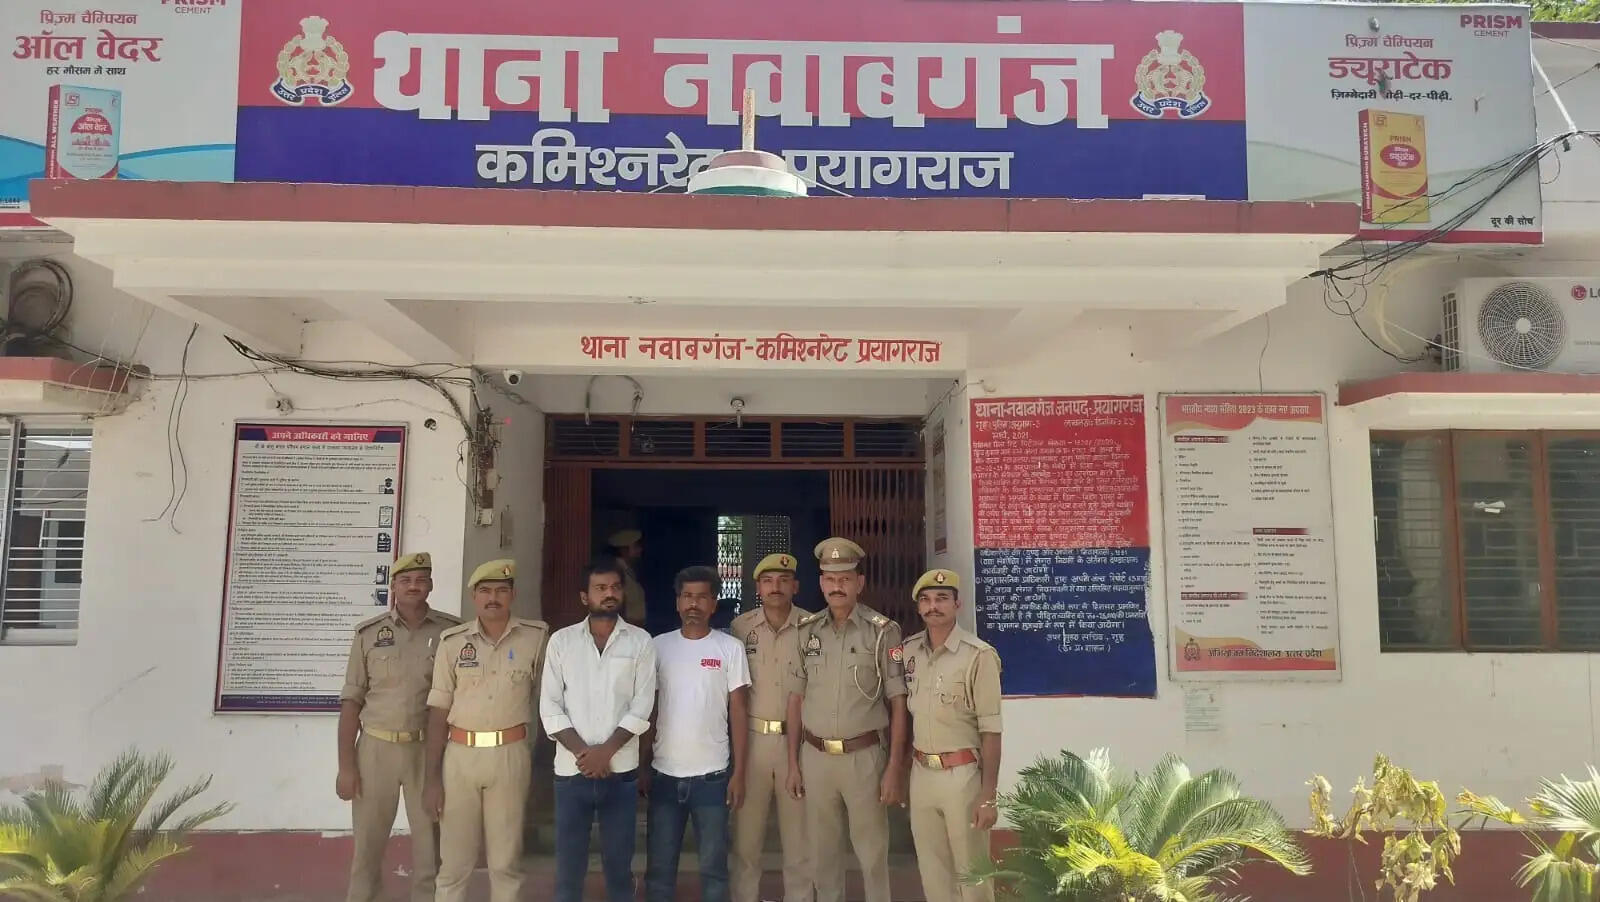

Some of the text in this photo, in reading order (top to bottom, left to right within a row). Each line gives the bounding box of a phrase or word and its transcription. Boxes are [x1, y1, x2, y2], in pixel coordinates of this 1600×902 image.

[81, 10, 137, 25] चैम्पियन
[174, 6, 212, 15] CEMENT
[1460, 15, 1522, 29] PRISM
[1474, 29, 1510, 38] CEMENT
[12, 29, 164, 62] ऑल वेदर
[1383, 34, 1435, 49] चैम्पियन
[46, 66, 60, 76] हर
[63, 65, 91, 76] मौसम
[105, 67, 127, 76] साथ
[373, 16, 1115, 129] थाना नवाबगंज
[1328, 51, 1453, 85] ड्यूराटेक
[1490, 214, 1536, 228] दूर की सोच
[580, 335, 629, 359] थाना
[855, 338, 942, 363] प्रयागराज
[1238, 404, 1256, 414] 2023
